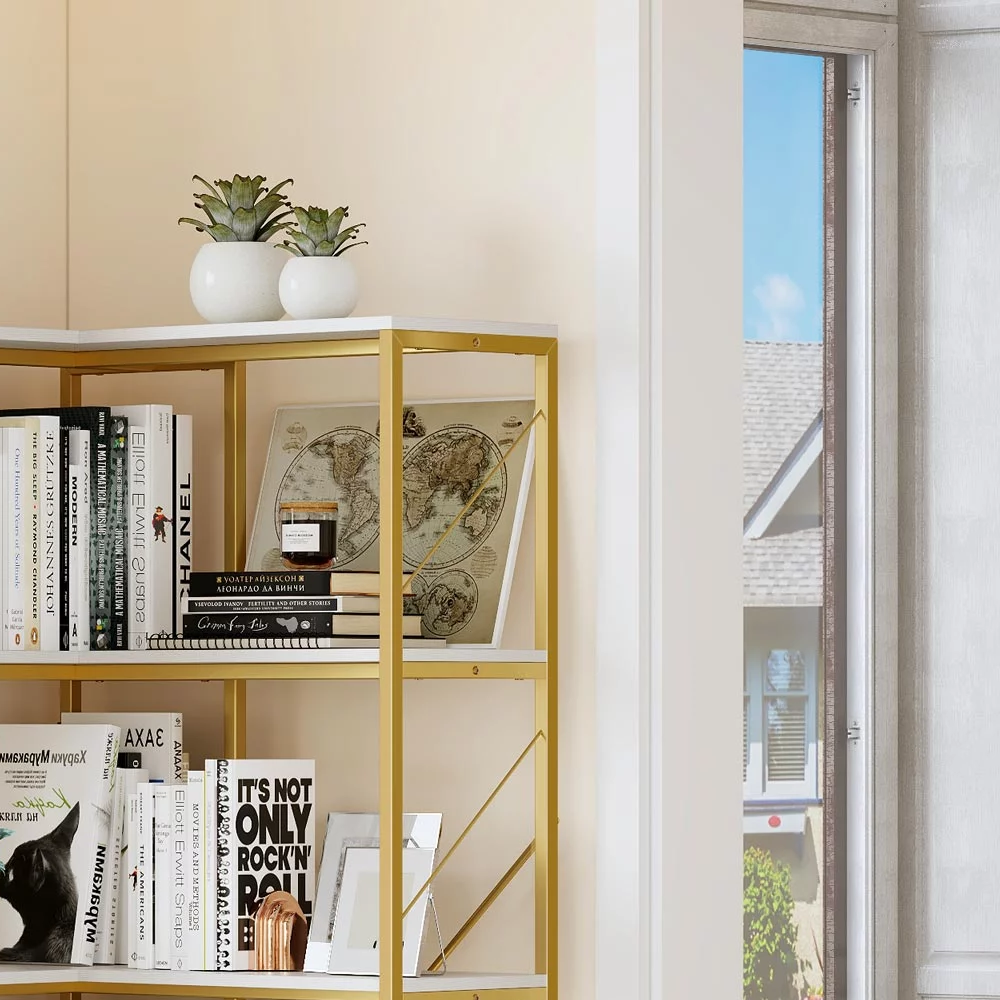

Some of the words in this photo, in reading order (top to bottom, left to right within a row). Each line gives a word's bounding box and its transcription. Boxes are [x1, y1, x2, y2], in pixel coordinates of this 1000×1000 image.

[97, 450, 106, 506] MATHEMATICAL
[97, 507, 106, 536] MOSAIC
[14, 540, 21, 550] of
[45, 520, 54, 616] JOHANNES
[175, 790, 185, 834] Elliott
[238, 778, 270, 803] IT'S
[275, 778, 312, 803] NOT
[236, 803, 312, 845] ONLY
[175, 840, 185, 887] Erwitt
[238, 845, 311, 871] ROCK'N'
[174, 893, 185, 949] Snaps
